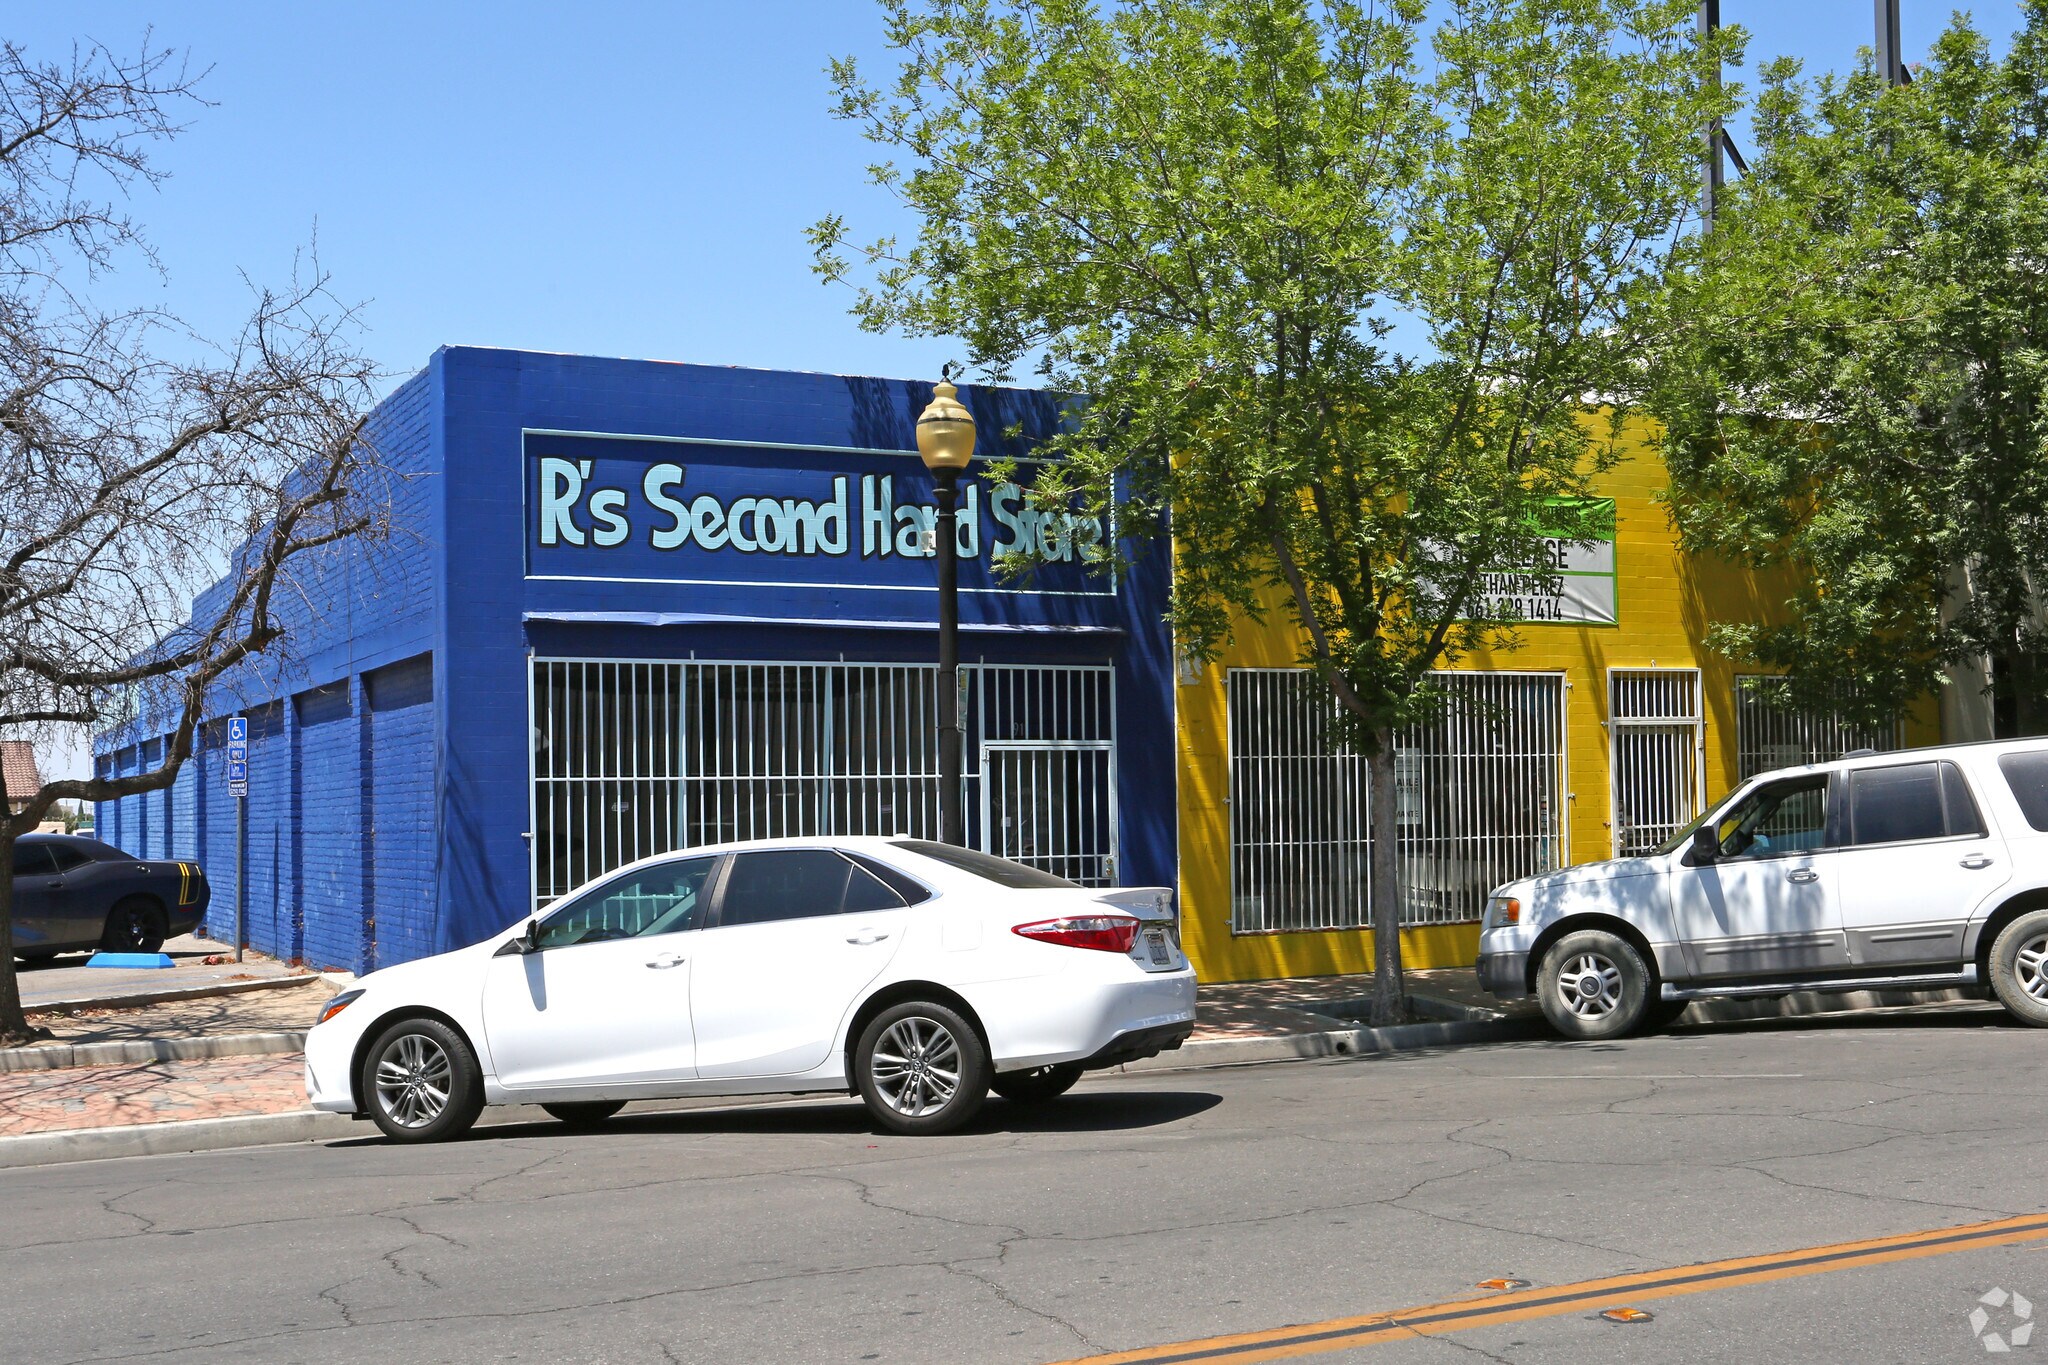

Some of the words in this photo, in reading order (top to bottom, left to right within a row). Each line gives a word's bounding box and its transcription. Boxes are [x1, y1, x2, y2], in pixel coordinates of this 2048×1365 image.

[539, 456, 629, 547] R's
[642, 462, 847, 554] Second
[861, 474, 980, 559] Hand
[991, 482, 1104, 563] Store
[1521, 575, 1565, 597] PEREZ
